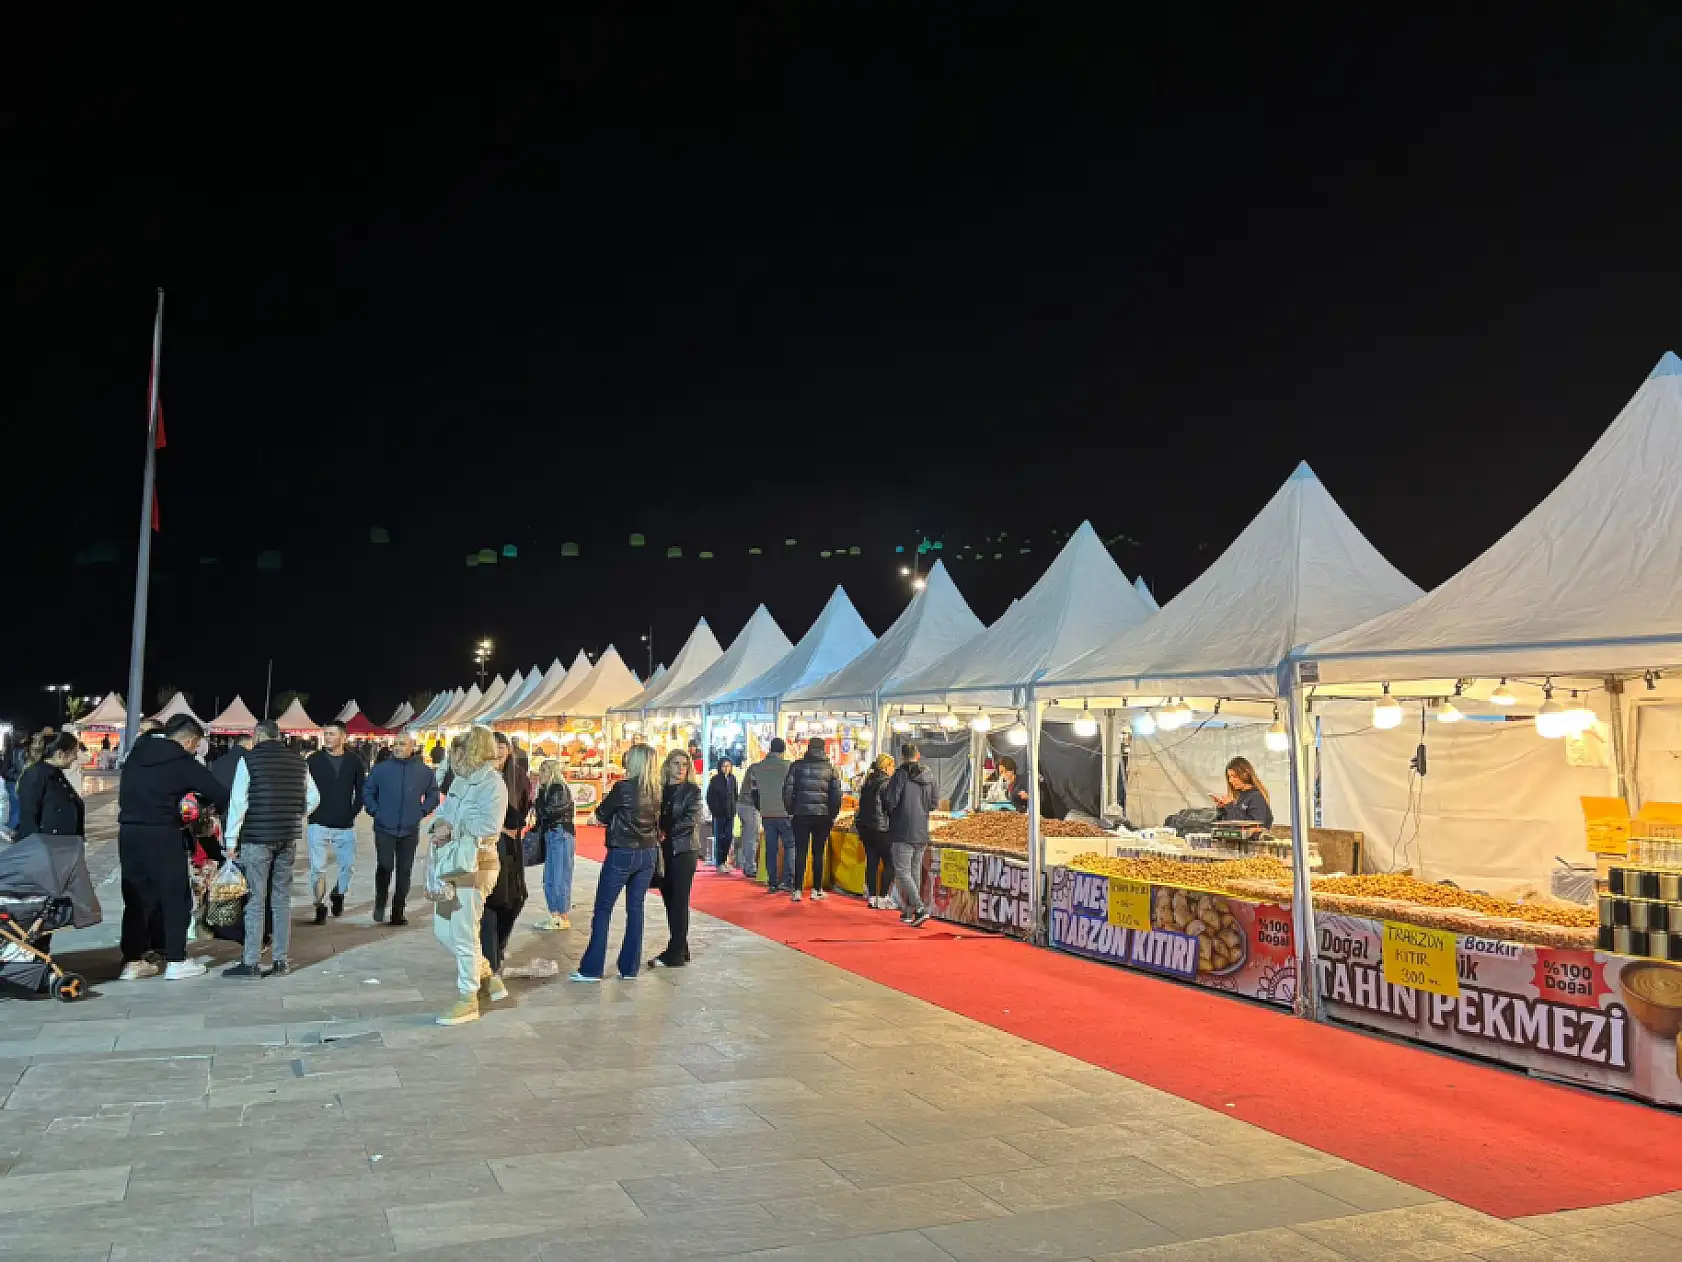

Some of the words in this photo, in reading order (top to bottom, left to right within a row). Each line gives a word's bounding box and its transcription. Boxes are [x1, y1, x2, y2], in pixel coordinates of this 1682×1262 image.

[979, 891, 1030, 928] EKME
[1321, 928, 1368, 960] Doğal
[1464, 935, 1519, 957] Bozkır
[1400, 967, 1426, 985] 300
[1543, 958, 1593, 980] %100
[1544, 974, 1593, 996] Doğal
[1431, 987, 1626, 1068] PEKMEZİ
